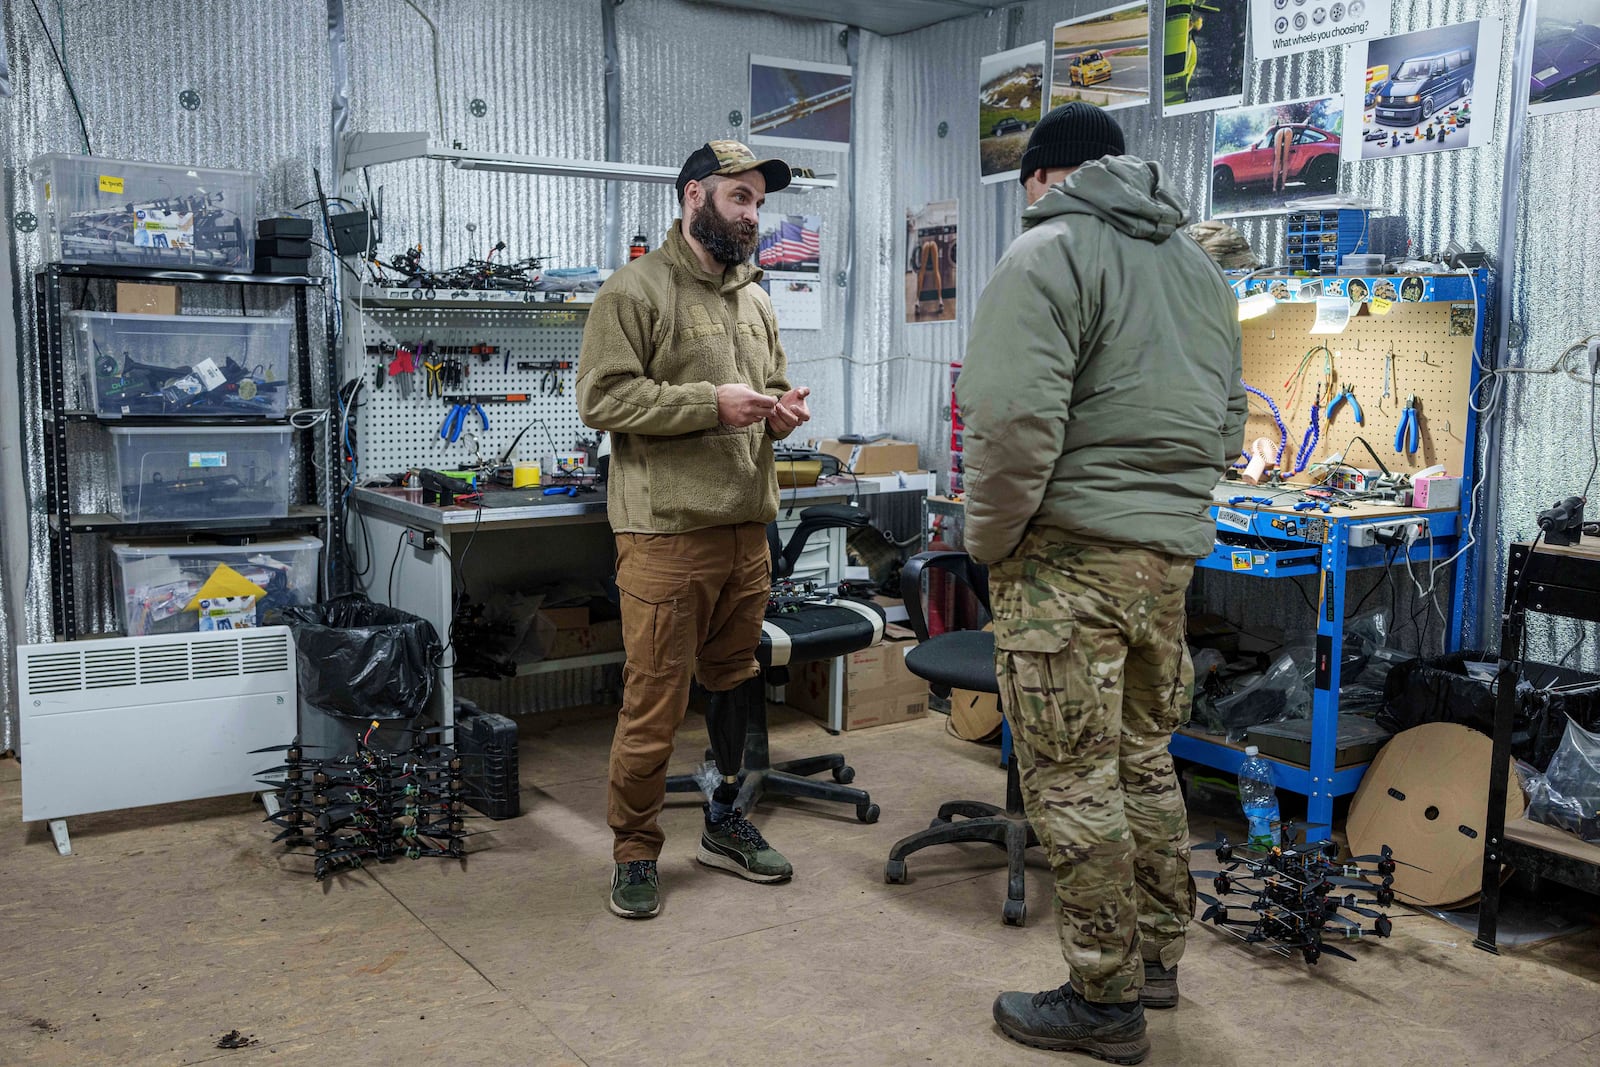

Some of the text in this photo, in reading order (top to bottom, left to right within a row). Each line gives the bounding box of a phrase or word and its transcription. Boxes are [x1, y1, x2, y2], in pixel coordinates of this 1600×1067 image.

[1272, 20, 1369, 49] What wheels you choosing?
